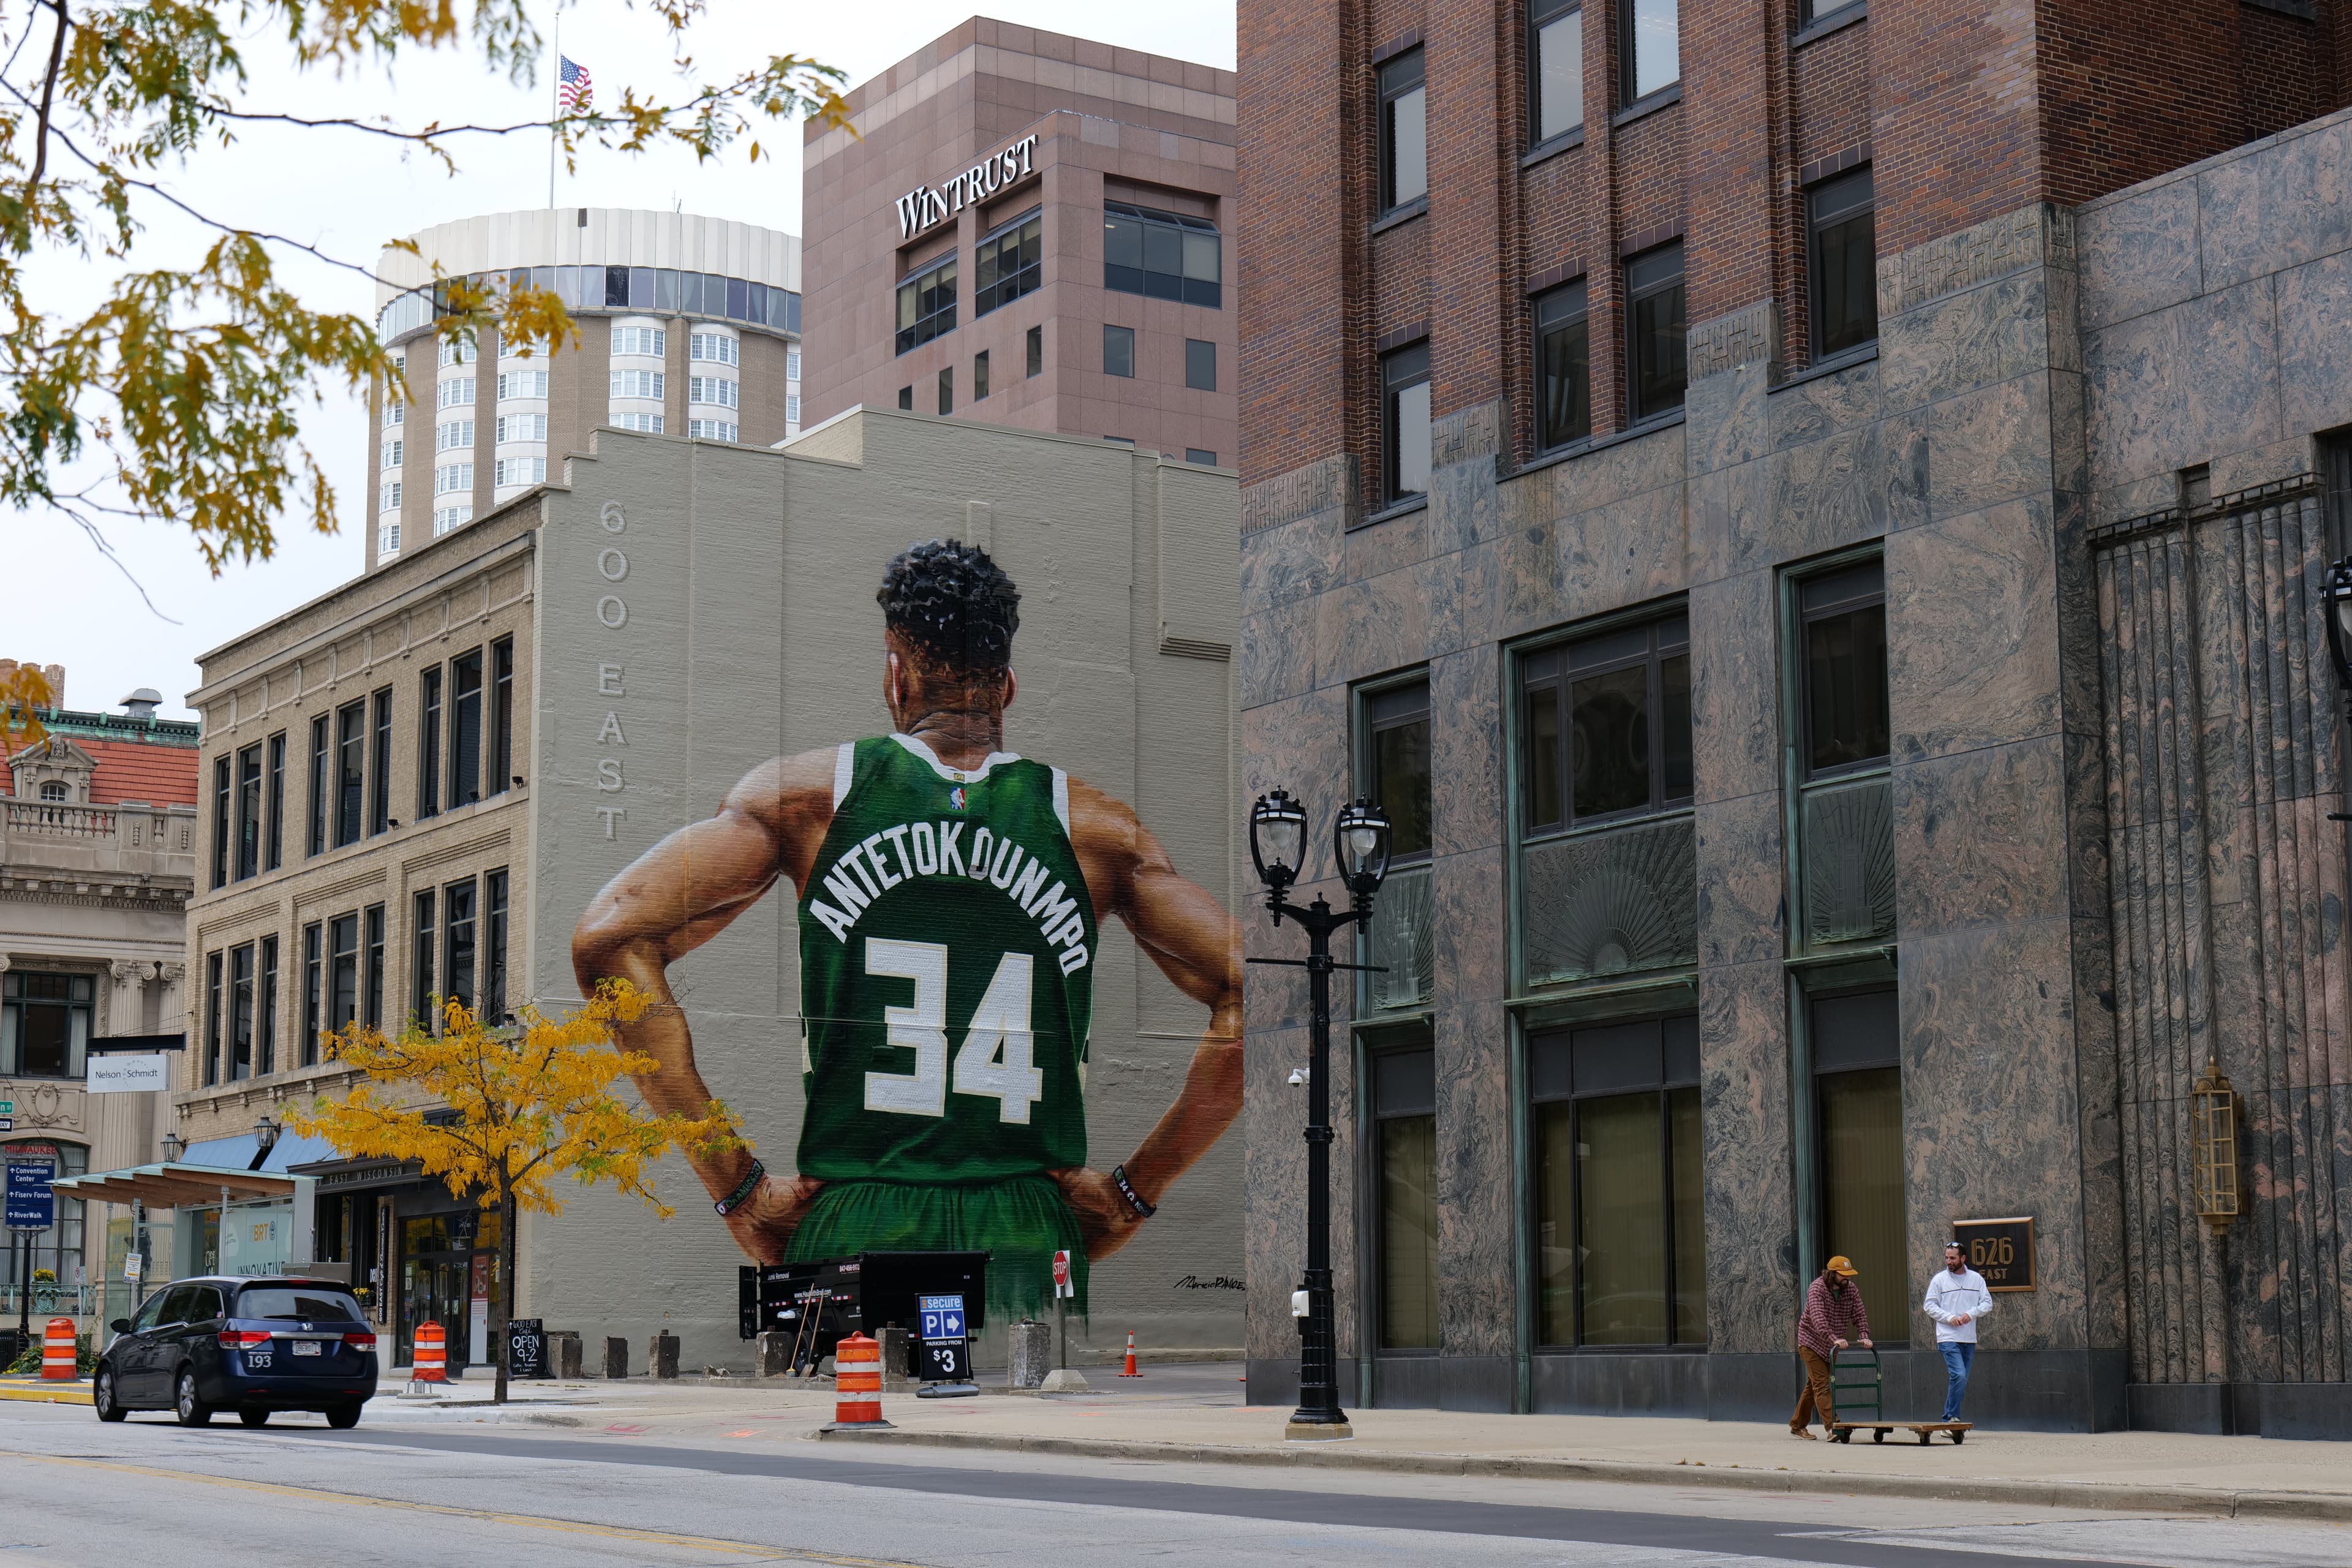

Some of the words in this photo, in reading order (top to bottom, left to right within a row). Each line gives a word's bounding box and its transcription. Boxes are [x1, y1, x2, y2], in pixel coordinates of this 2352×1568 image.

[896, 134, 1039, 239] WINTRUST
[597, 499, 630, 630] 600
[596, 663, 630, 842] EAST
[809, 821, 1089, 978] ANTETOKOUNMPO
[864, 937, 1044, 1125] 34
[127, 1069, 158, 1078] Schmidt
[5, 1145, 56, 1154] MILWAUKEE
[330, 1174, 349, 1185] EAST
[357, 1166, 402, 1182] WISCONSIN
[1119, 1180, 1129, 1191] 34
[254, 1223, 269, 1242] BRT
[1971, 1237, 2014, 1266] 626
[238, 1261, 285, 1275] INNOVATIV
[1054, 1261, 1066, 1275] STOP
[927, 1297, 961, 1309] secure
[513, 1320, 525, 1329] 600
[526, 1319, 538, 1328] EAST
[925, 1315, 938, 1333] P
[512, 1335, 539, 1349] OPEN
[247, 1355, 272, 1368] 193
[518, 1348, 538, 1362] 9-2
